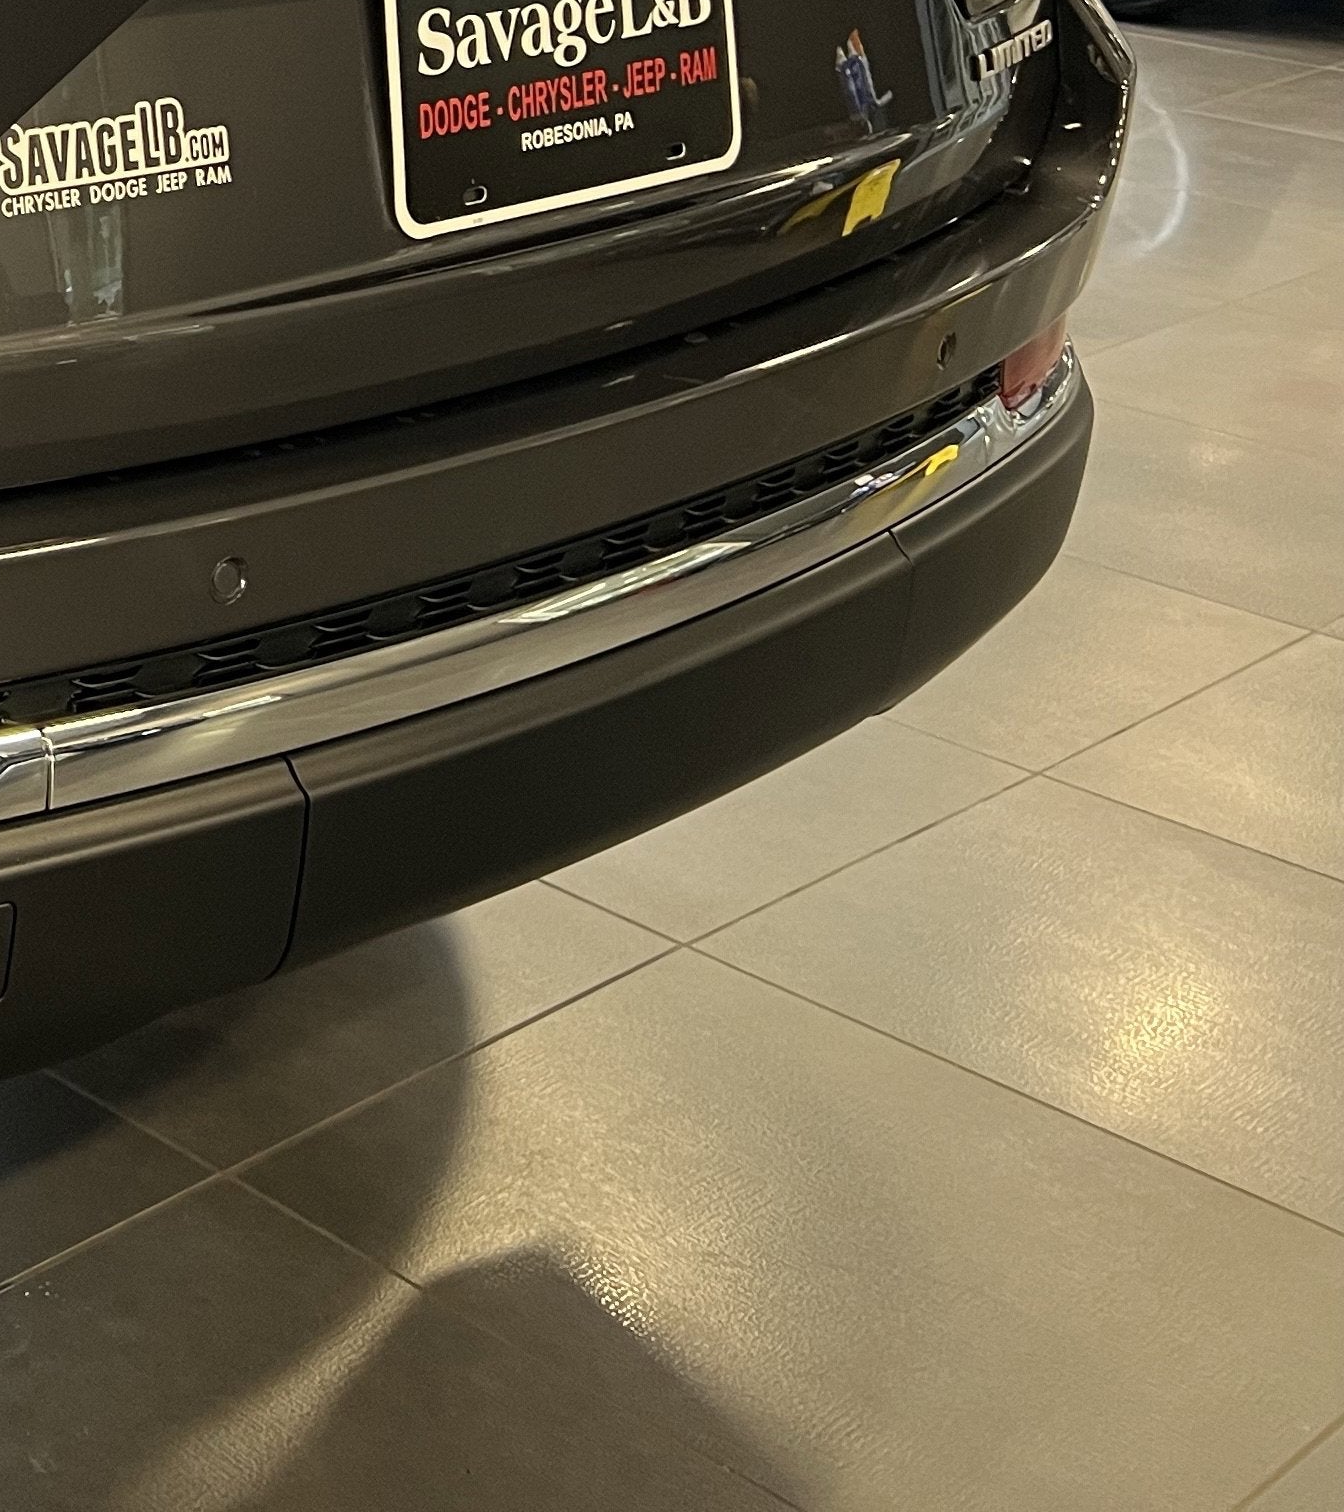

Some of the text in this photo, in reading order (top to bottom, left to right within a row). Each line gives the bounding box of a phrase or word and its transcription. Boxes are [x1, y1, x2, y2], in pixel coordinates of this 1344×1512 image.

[978, 19, 1053, 80] LIMITED
[419, 46, 717, 139] DODGE CHRYSLER JEEP RAM
[521, 111, 634, 151] ROBESONIA, PA
[1, 165, 232, 218] CHRYSLER DODGE JEEP RAM
